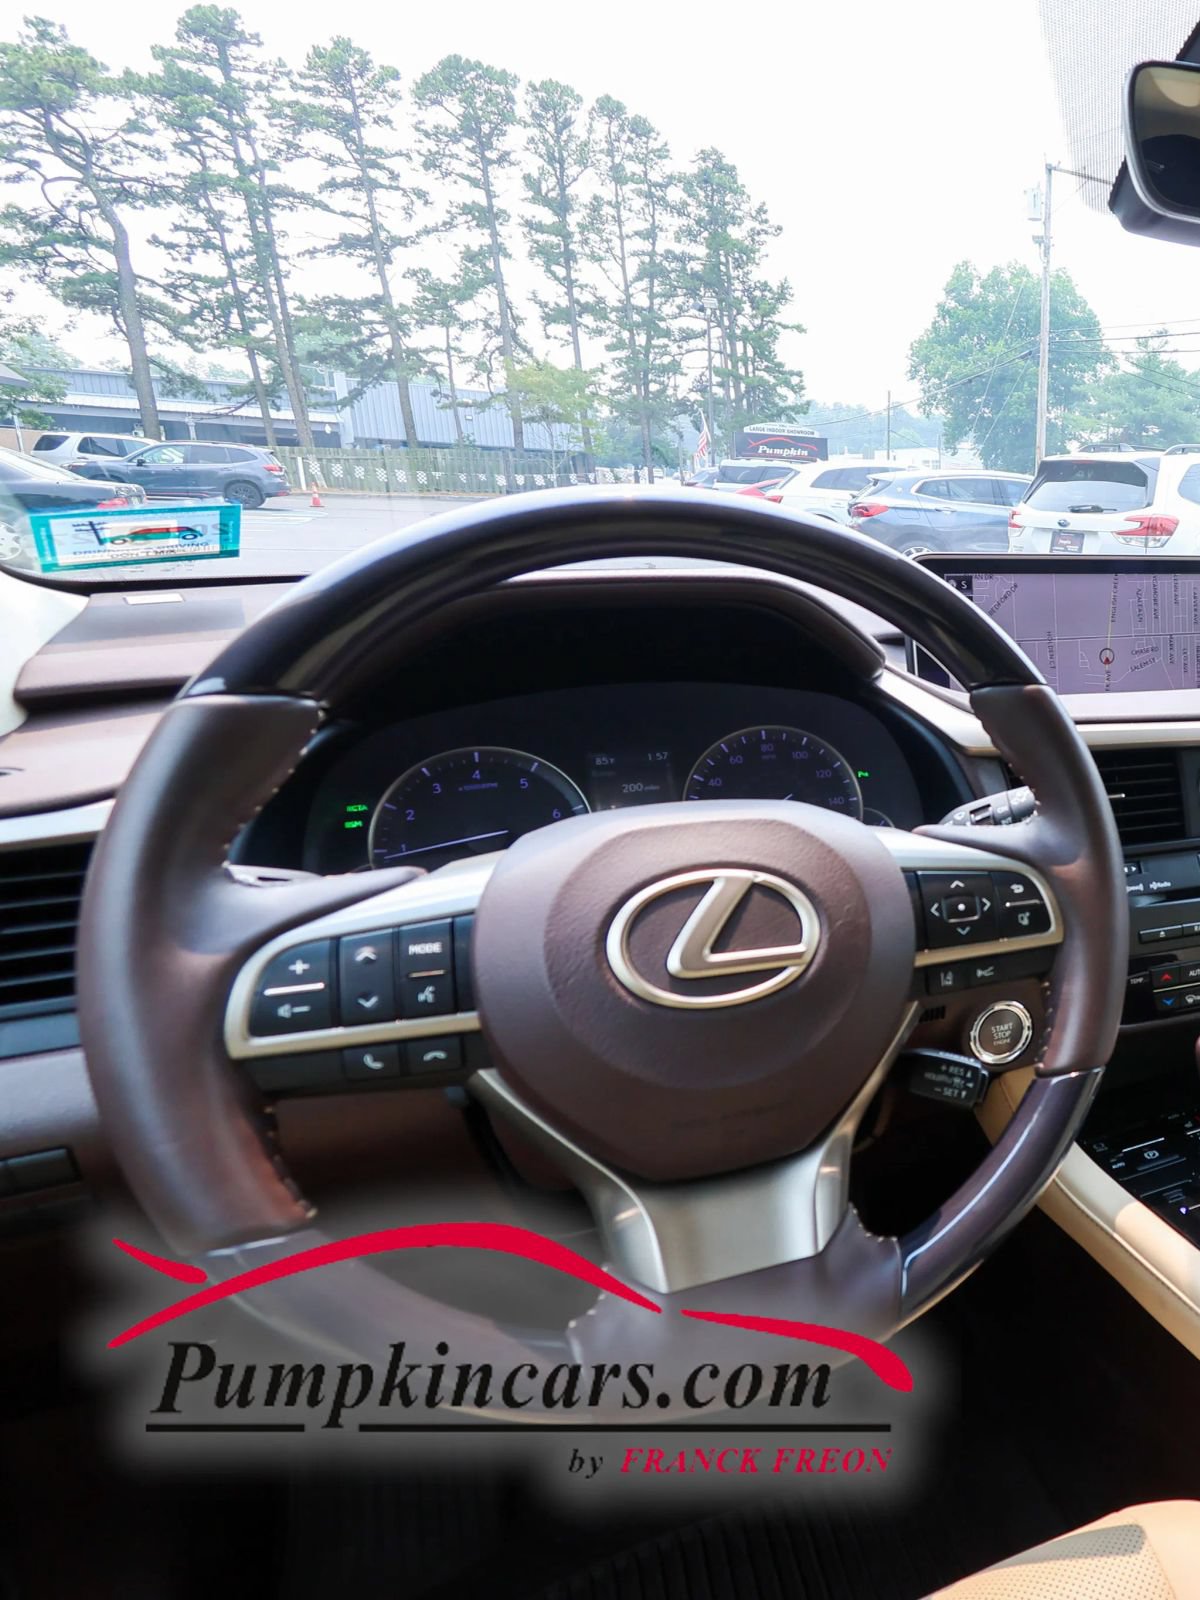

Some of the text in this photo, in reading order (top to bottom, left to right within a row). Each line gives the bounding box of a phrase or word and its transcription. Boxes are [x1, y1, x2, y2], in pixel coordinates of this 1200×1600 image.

[758, 445, 808, 457] Pumpkin
[961, 580, 967, 589] S
[1111, 595, 1119, 622] ENGLISH
[760, 743, 774, 753] 80
[729, 755, 743, 765] 60
[792, 751, 808, 761] 100
[472, 769, 481, 780] 4
[816, 769, 832, 779] 120
[519, 778, 529, 788] 5
[708, 777, 722, 787] 40
[432, 783, 441, 794] 3
[622, 782, 643, 793] 200
[829, 796, 845, 806] 140
[405, 809, 415, 821] 2
[552, 808, 561, 818] 6
[408, 942, 443, 955] MODE
[1130, 977, 1144, 985] TEMP
[991, 1022, 1013, 1034] START
[993, 1031, 1012, 1041] STOP
[942, 1087, 959, 1097] SET
